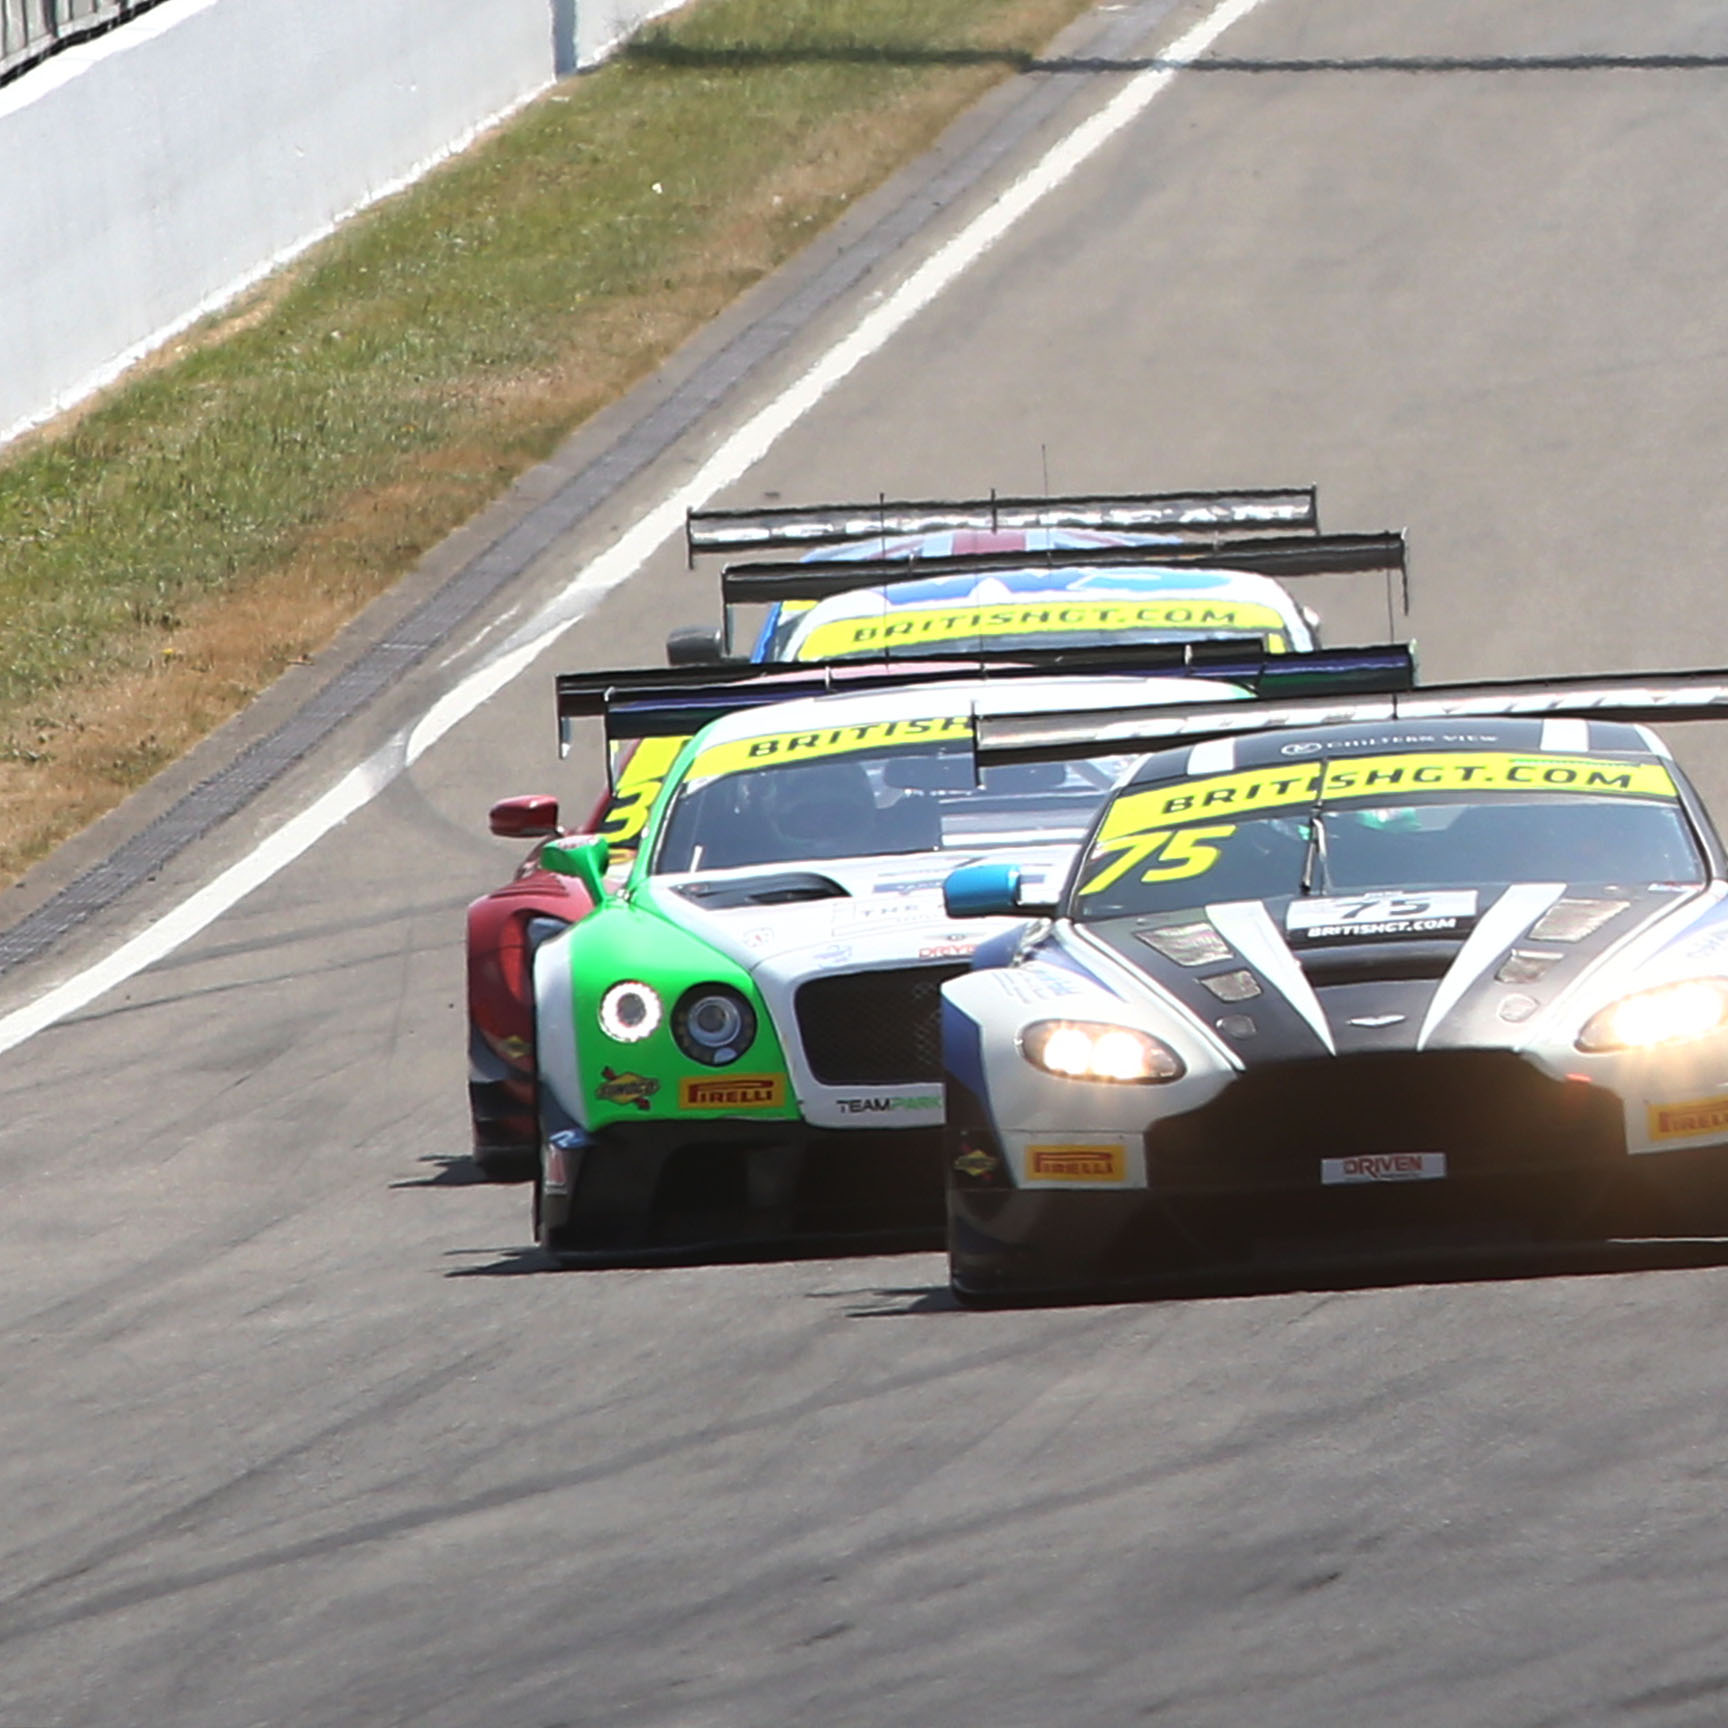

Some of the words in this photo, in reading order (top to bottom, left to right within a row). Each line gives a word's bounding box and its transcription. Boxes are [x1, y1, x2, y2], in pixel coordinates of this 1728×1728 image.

[853, 605, 1237, 644] BRITISHGT.COM
[748, 715, 976, 759] BRITISH
[1161, 761, 1633, 816] BRITISHGT.COM
[1078, 823, 1239, 896] 75
[1335, 898, 1431, 921] 75
[1306, 918, 1458, 938] BRITISHGT.COM
[686, 1079, 775, 1104] PIRELLI
[835, 1095, 944, 1114] TEAMPARK
[1032, 1150, 1114, 1176] PIRELLI
[1343, 1153, 1424, 1178] DRIVEN
